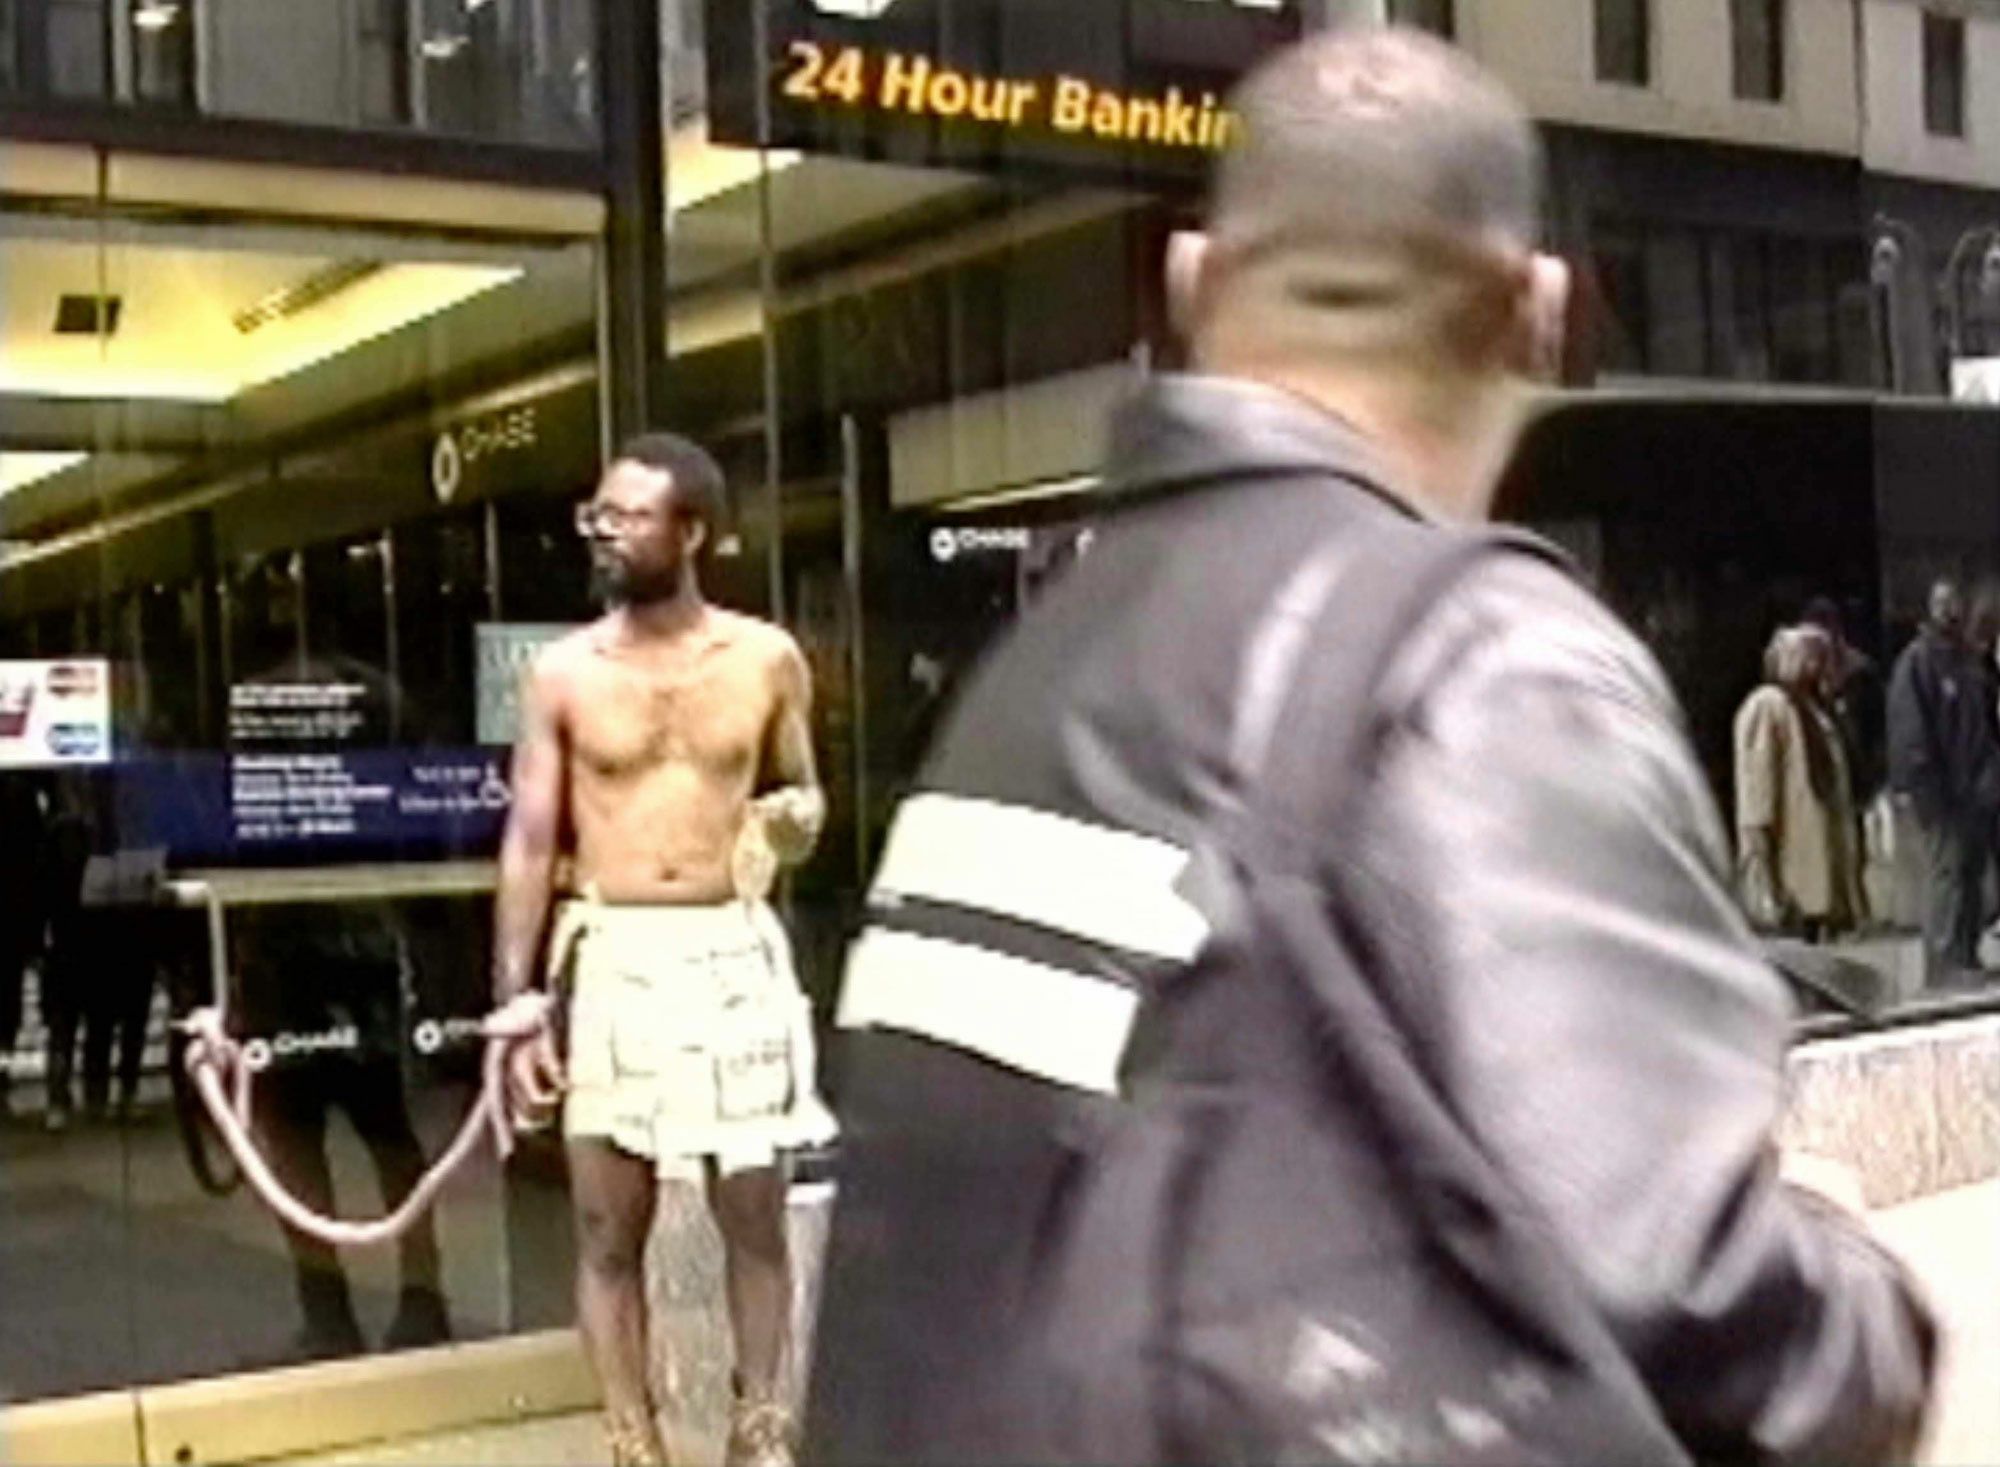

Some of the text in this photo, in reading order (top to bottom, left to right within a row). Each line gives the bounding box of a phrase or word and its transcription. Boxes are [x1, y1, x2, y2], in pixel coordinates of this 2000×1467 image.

[784, 41, 1248, 150] 24 Hour Bankin
[462, 406, 538, 462] CHASE
